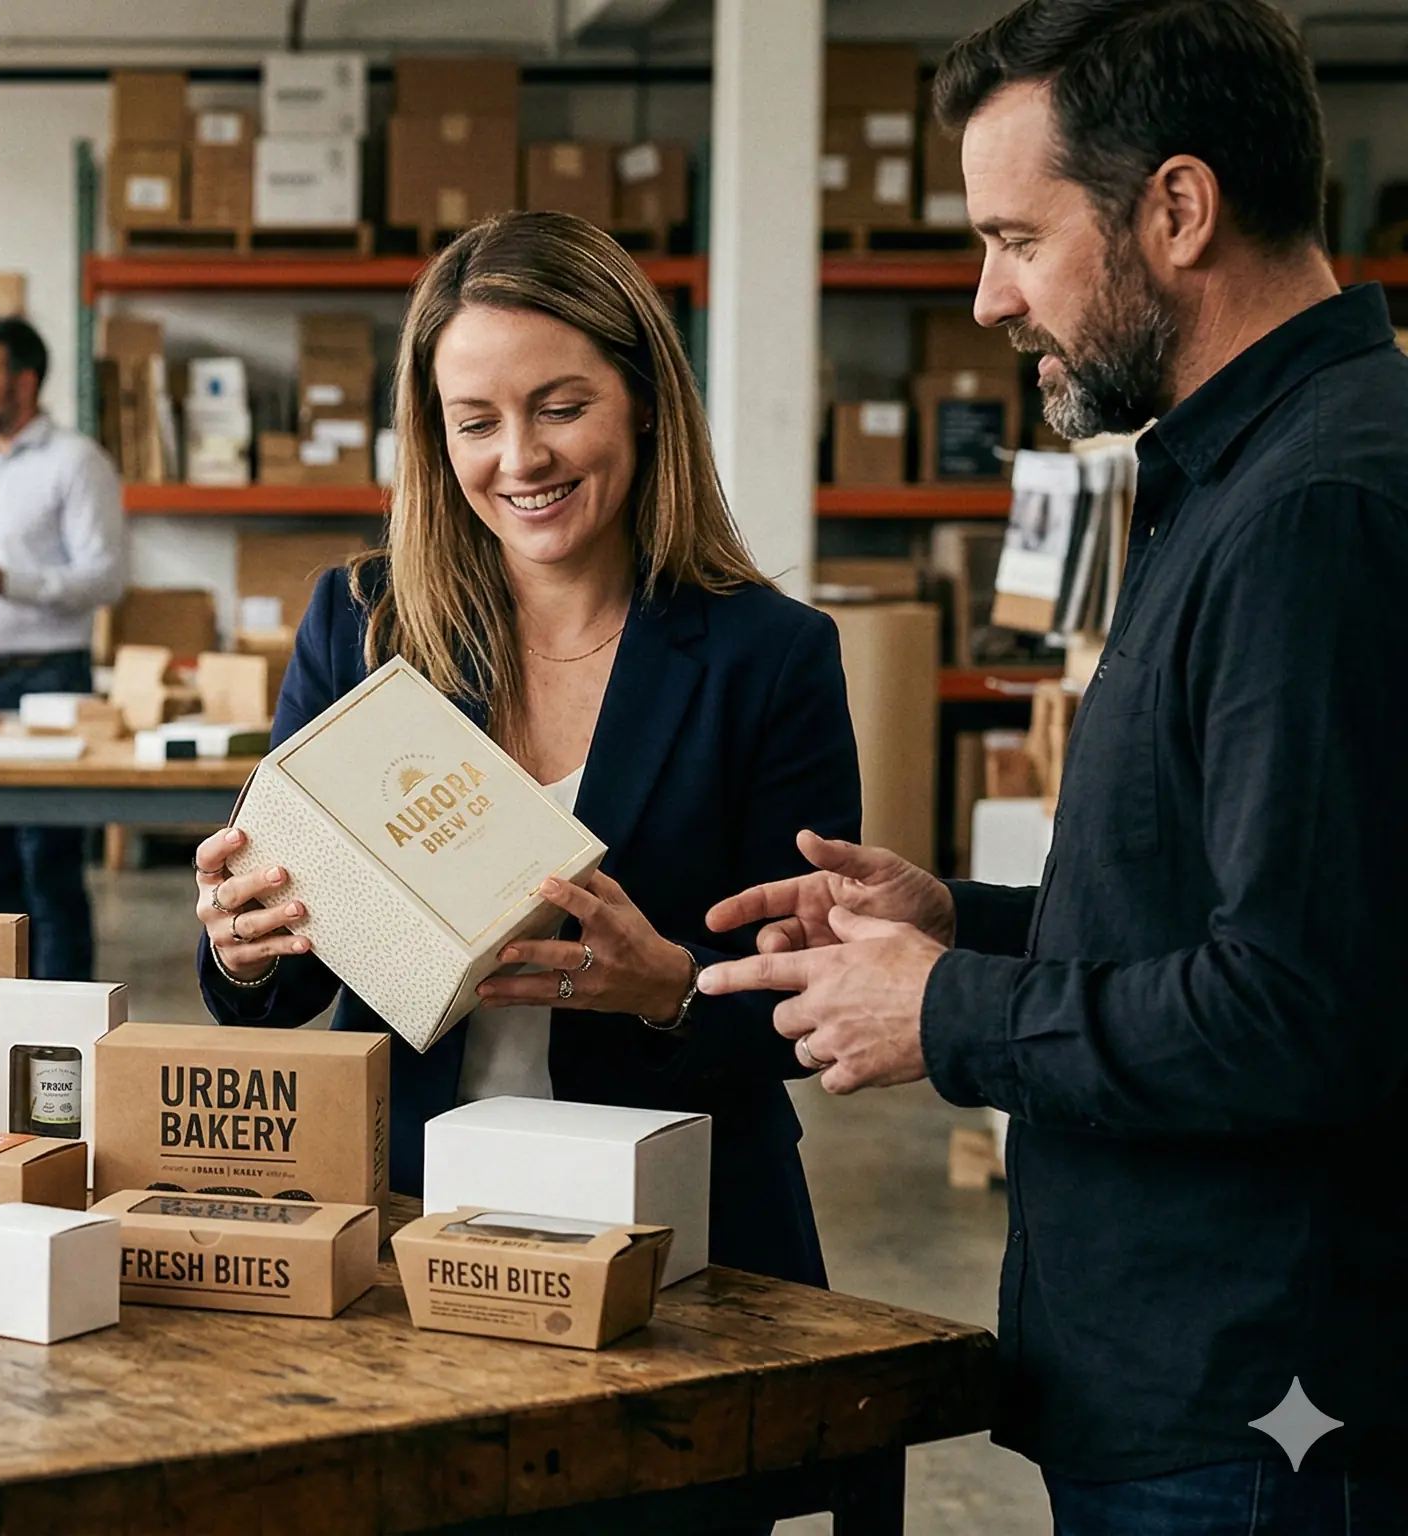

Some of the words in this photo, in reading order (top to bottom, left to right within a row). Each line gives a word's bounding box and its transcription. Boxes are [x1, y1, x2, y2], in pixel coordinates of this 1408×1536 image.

[385, 761, 489, 848] AURORA
[420, 811, 468, 855] BREW
[160, 1065, 297, 1112] URBAN
[160, 1111, 297, 1153] BAKERY
[120, 1247, 204, 1283] FRESH
[214, 1254, 291, 1289] BITES
[428, 1257, 499, 1291] FRESH
[507, 1266, 572, 1300] BITES
